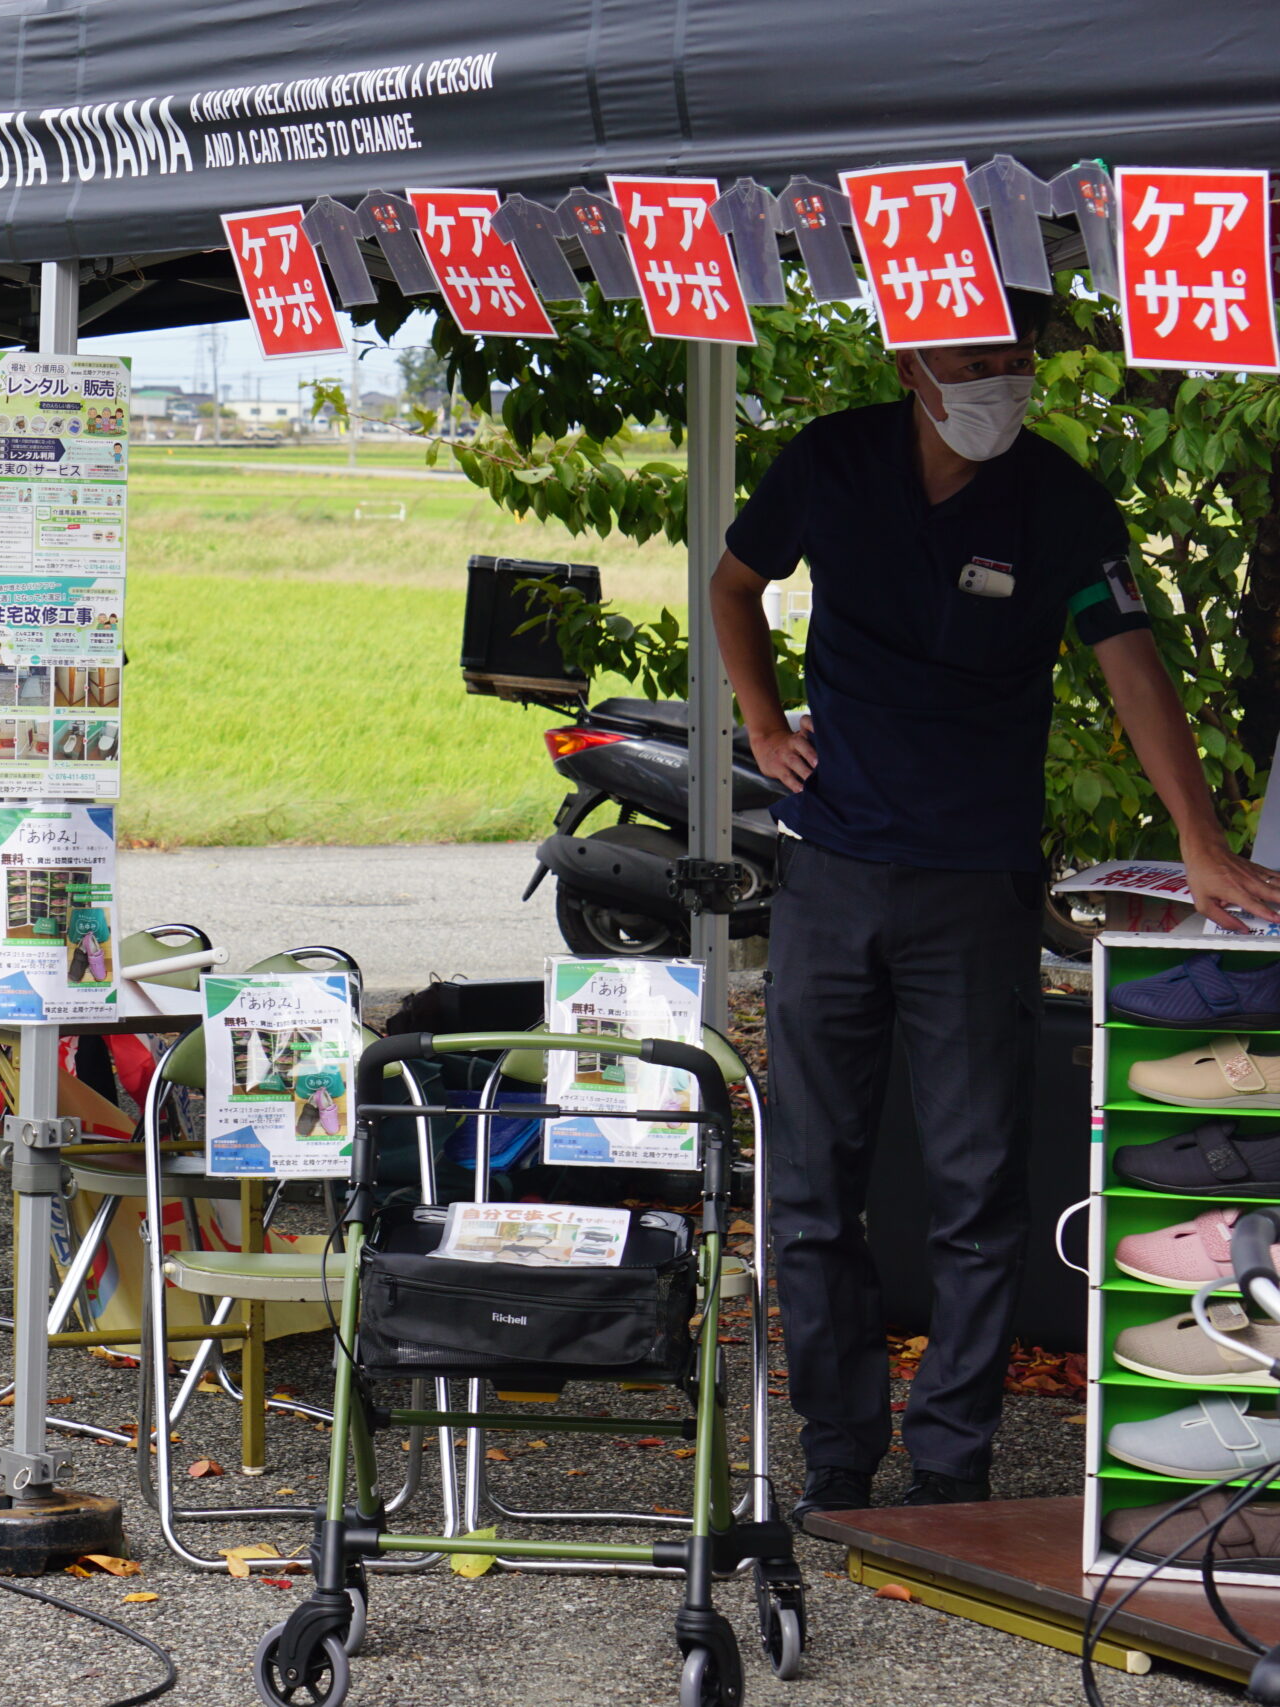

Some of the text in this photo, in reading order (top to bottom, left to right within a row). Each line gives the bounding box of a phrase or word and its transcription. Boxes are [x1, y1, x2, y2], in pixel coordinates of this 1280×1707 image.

[190, 52, 497, 122] A HAPPY RELATION BETWEEN A PERSON
[39, 95, 193, 182] TOYAMA
[205, 112, 422, 168] AND A CAR TRIES TO CHANGE.
[425, 202, 492, 258] ケア
[628, 192, 709, 252] ケア
[865, 182, 957, 249] ケア
[1131, 185, 1249, 259] ケア
[241, 222, 299, 279] ケア
[256, 278, 322, 338] サポ
[445, 264, 525, 317] サポ
[645, 259, 730, 321] サポ
[881, 248, 984, 321] サポ
[1135, 268, 1250, 342] サポ
[8, 377, 114, 397] レンタル・販売
[34, 365, 65, 374] 介護用品
[10, 452, 56, 460] レンタル利用
[33, 464, 81, 477] サービス
[19, 829, 78, 844] 「あゆみ」
[462, 1208, 576, 1223] 自分で歩く!
[492, 1312, 527, 1326] Richell
